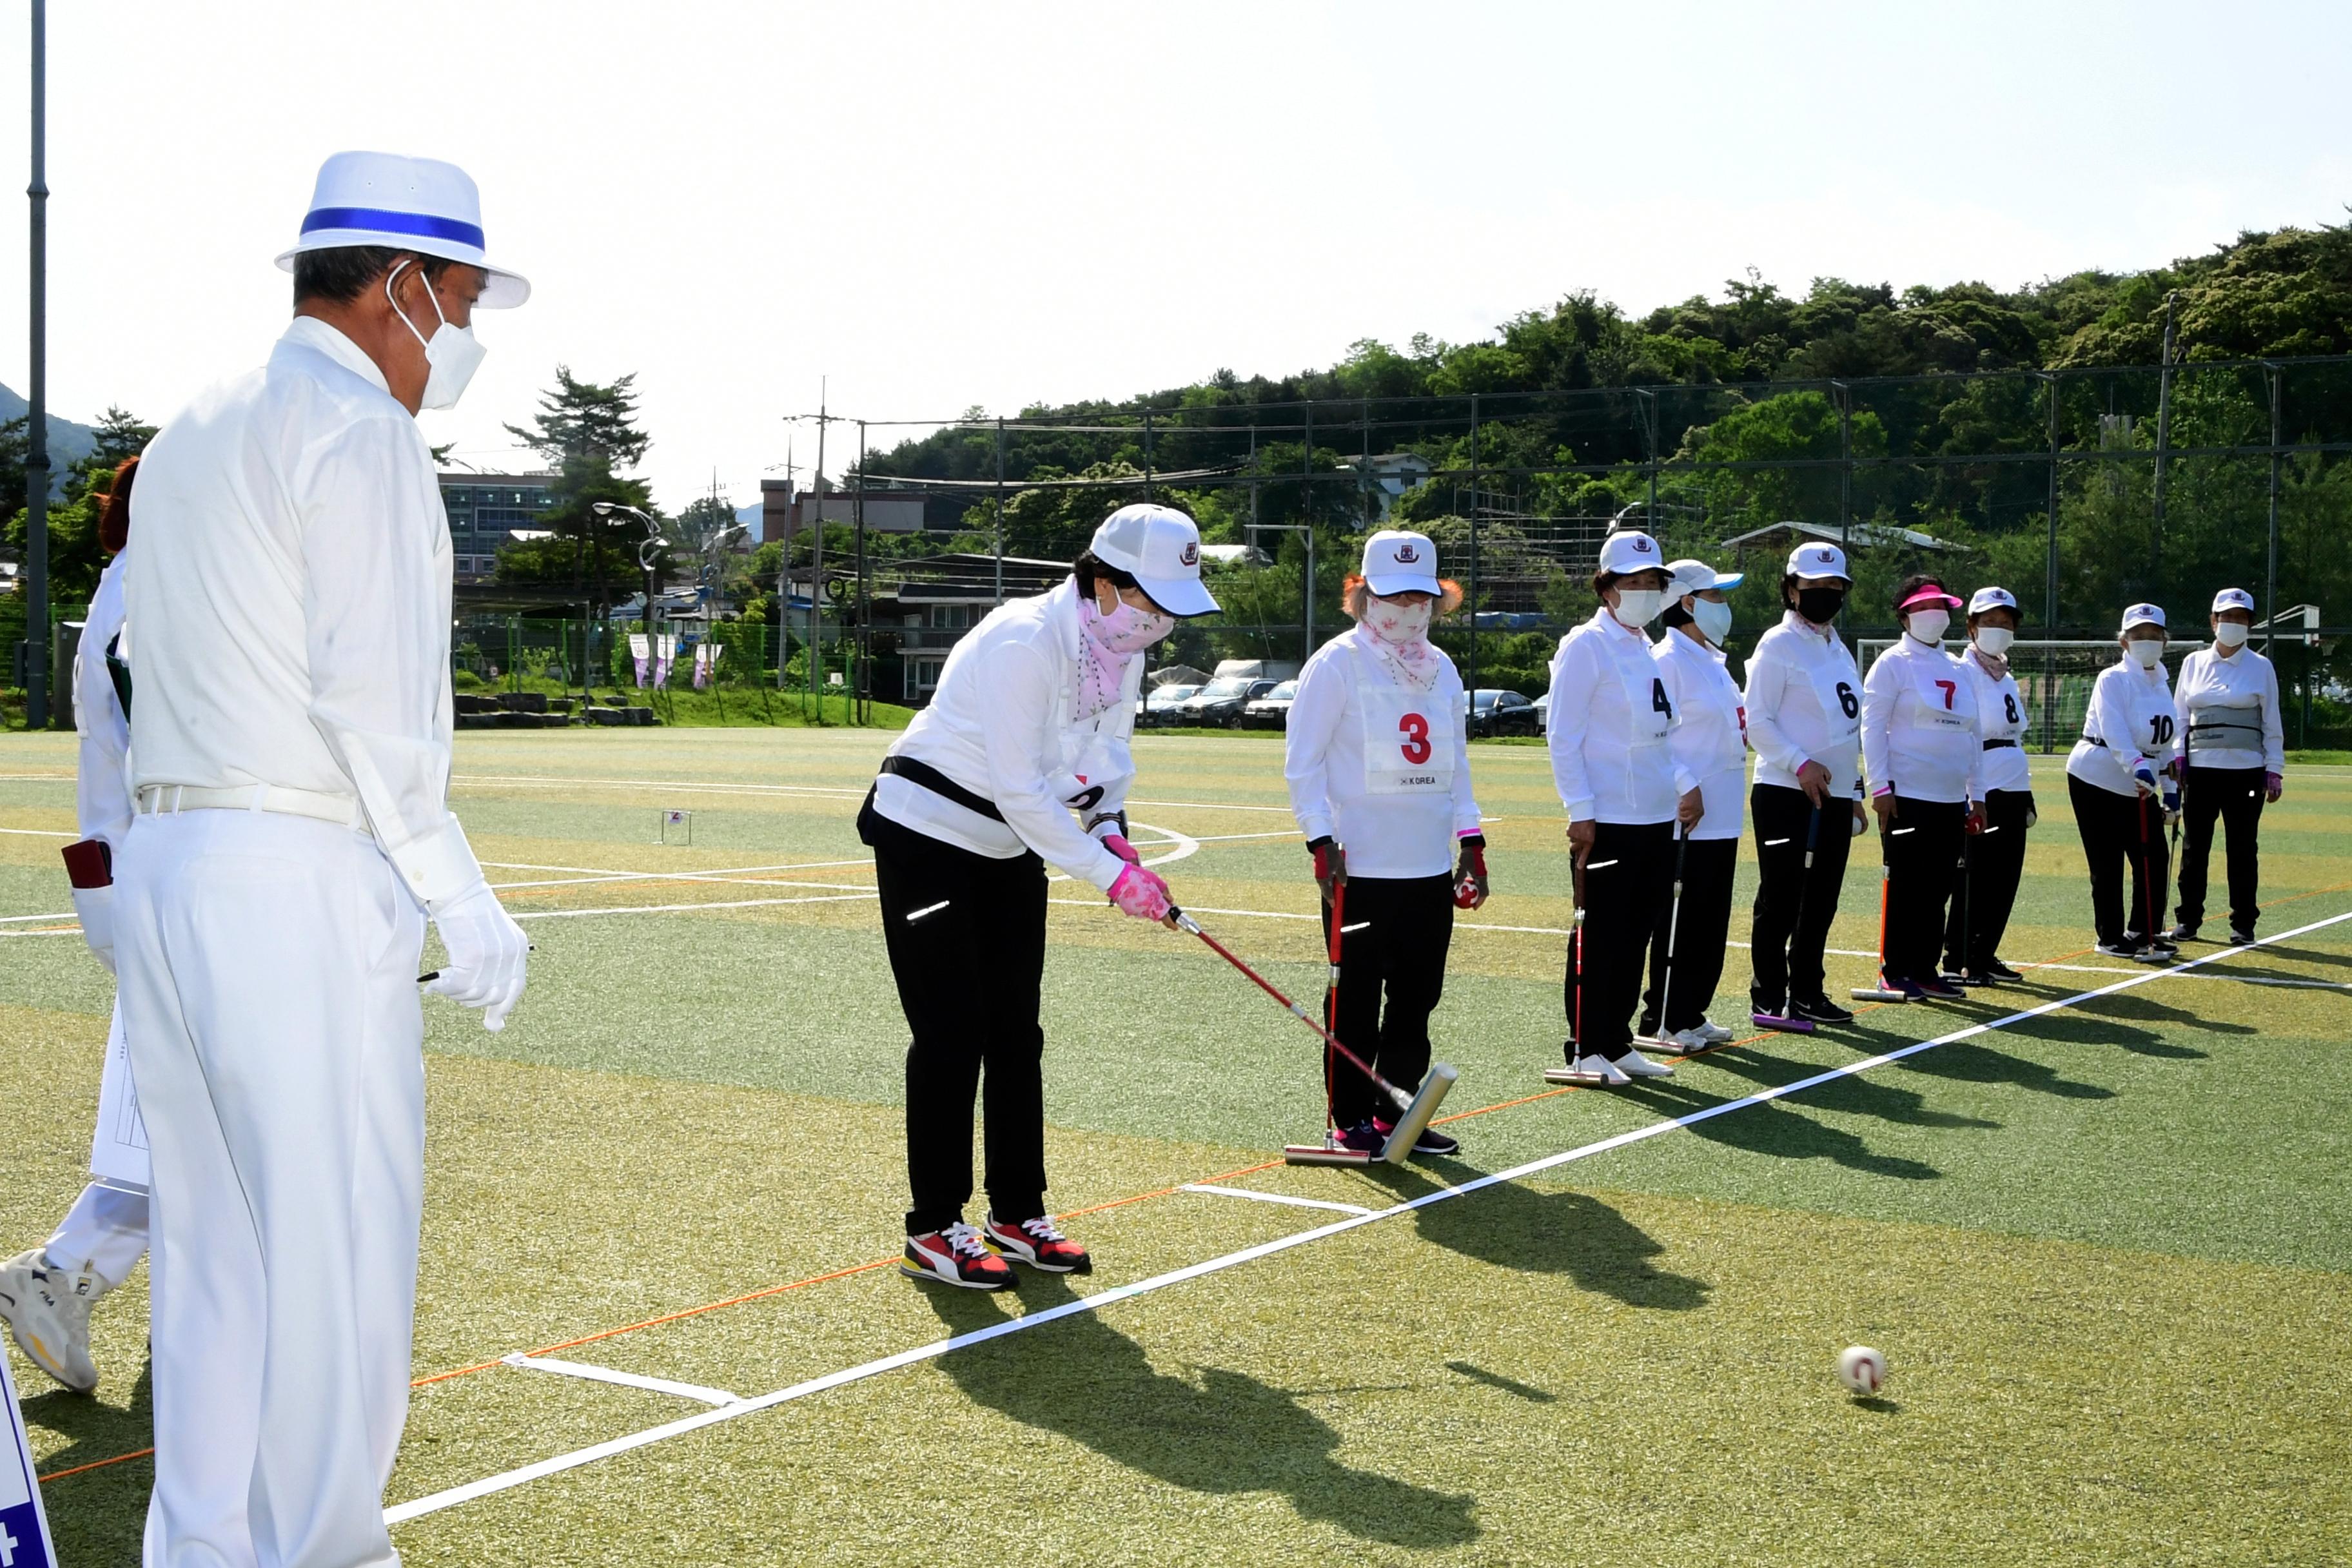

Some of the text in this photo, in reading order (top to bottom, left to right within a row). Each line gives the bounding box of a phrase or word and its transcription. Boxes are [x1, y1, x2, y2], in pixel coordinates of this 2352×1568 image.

[1652, 678, 1672, 720] 4
[1836, 681, 1859, 720] 6
[1935, 680, 1956, 710] 7
[2004, 693, 2019, 723] 8
[1399, 712, 1432, 765] 3
[2150, 714, 2174, 745] 10
[1409, 776, 1436, 785] KOREA
